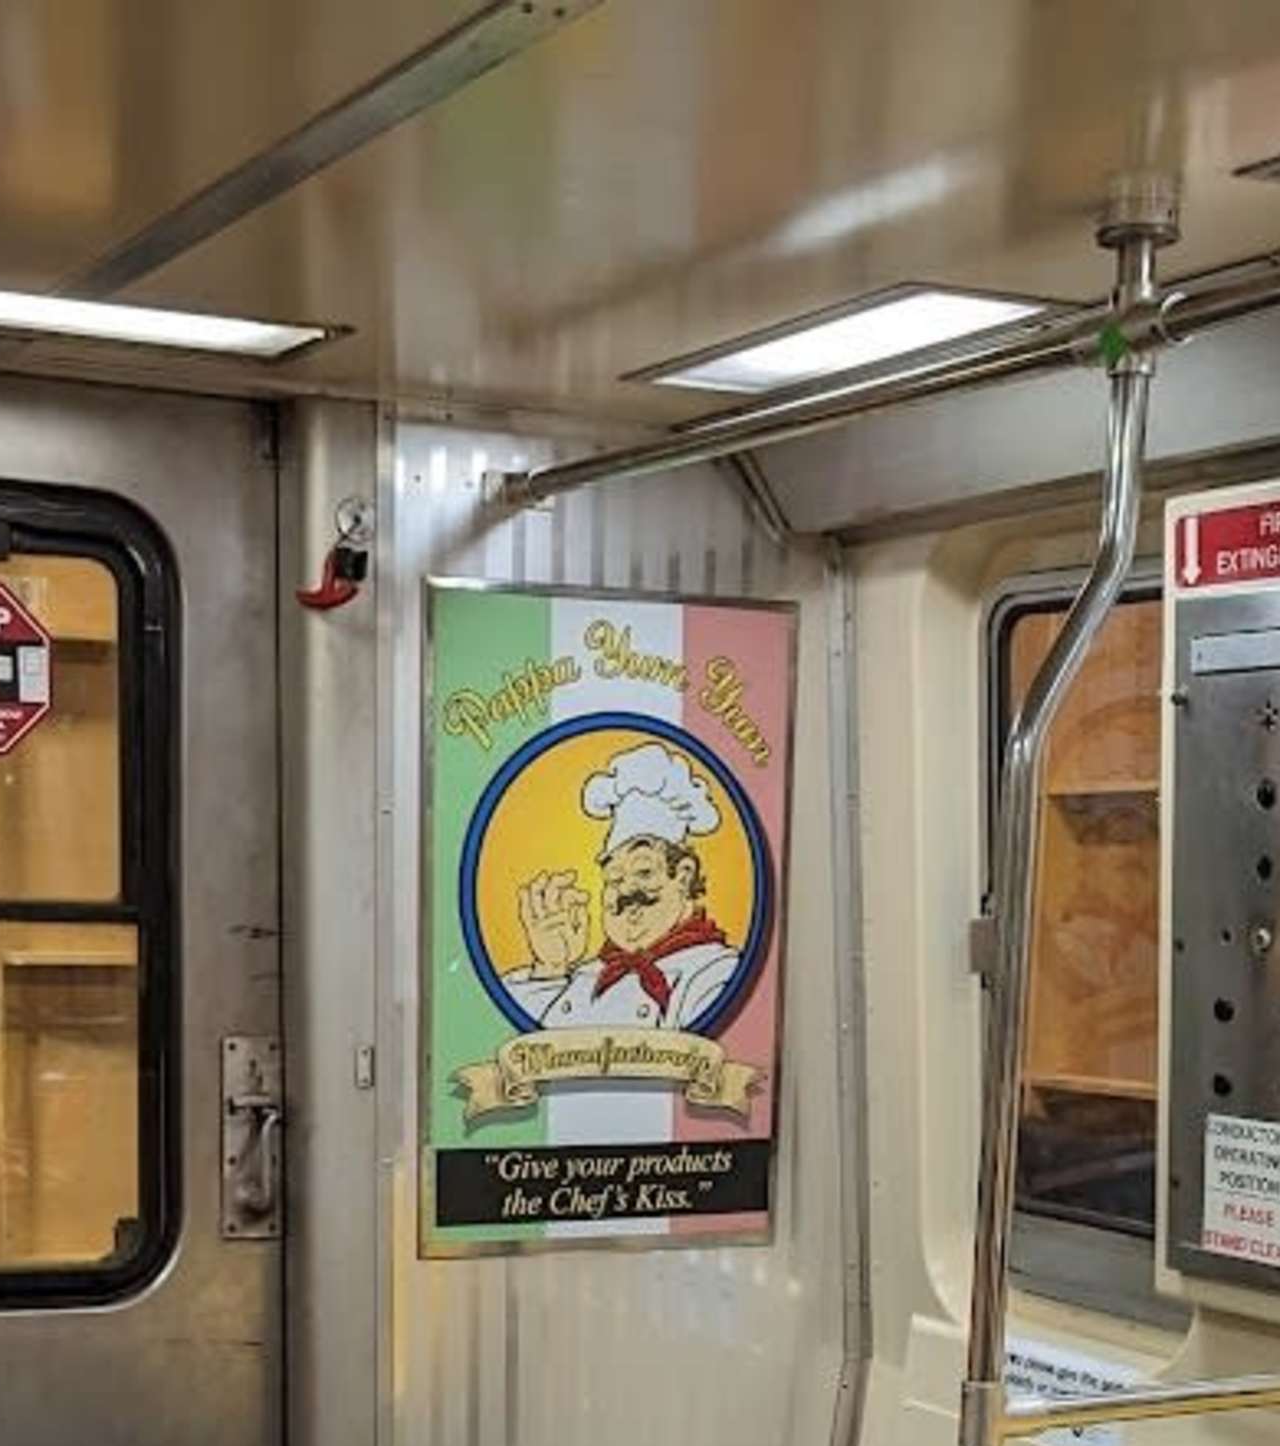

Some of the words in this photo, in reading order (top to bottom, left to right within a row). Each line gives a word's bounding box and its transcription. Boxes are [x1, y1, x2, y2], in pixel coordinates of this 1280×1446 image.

[561, 1153, 625, 1186] your
[627, 1146, 733, 1184] products
[502, 1189, 543, 1218] the
